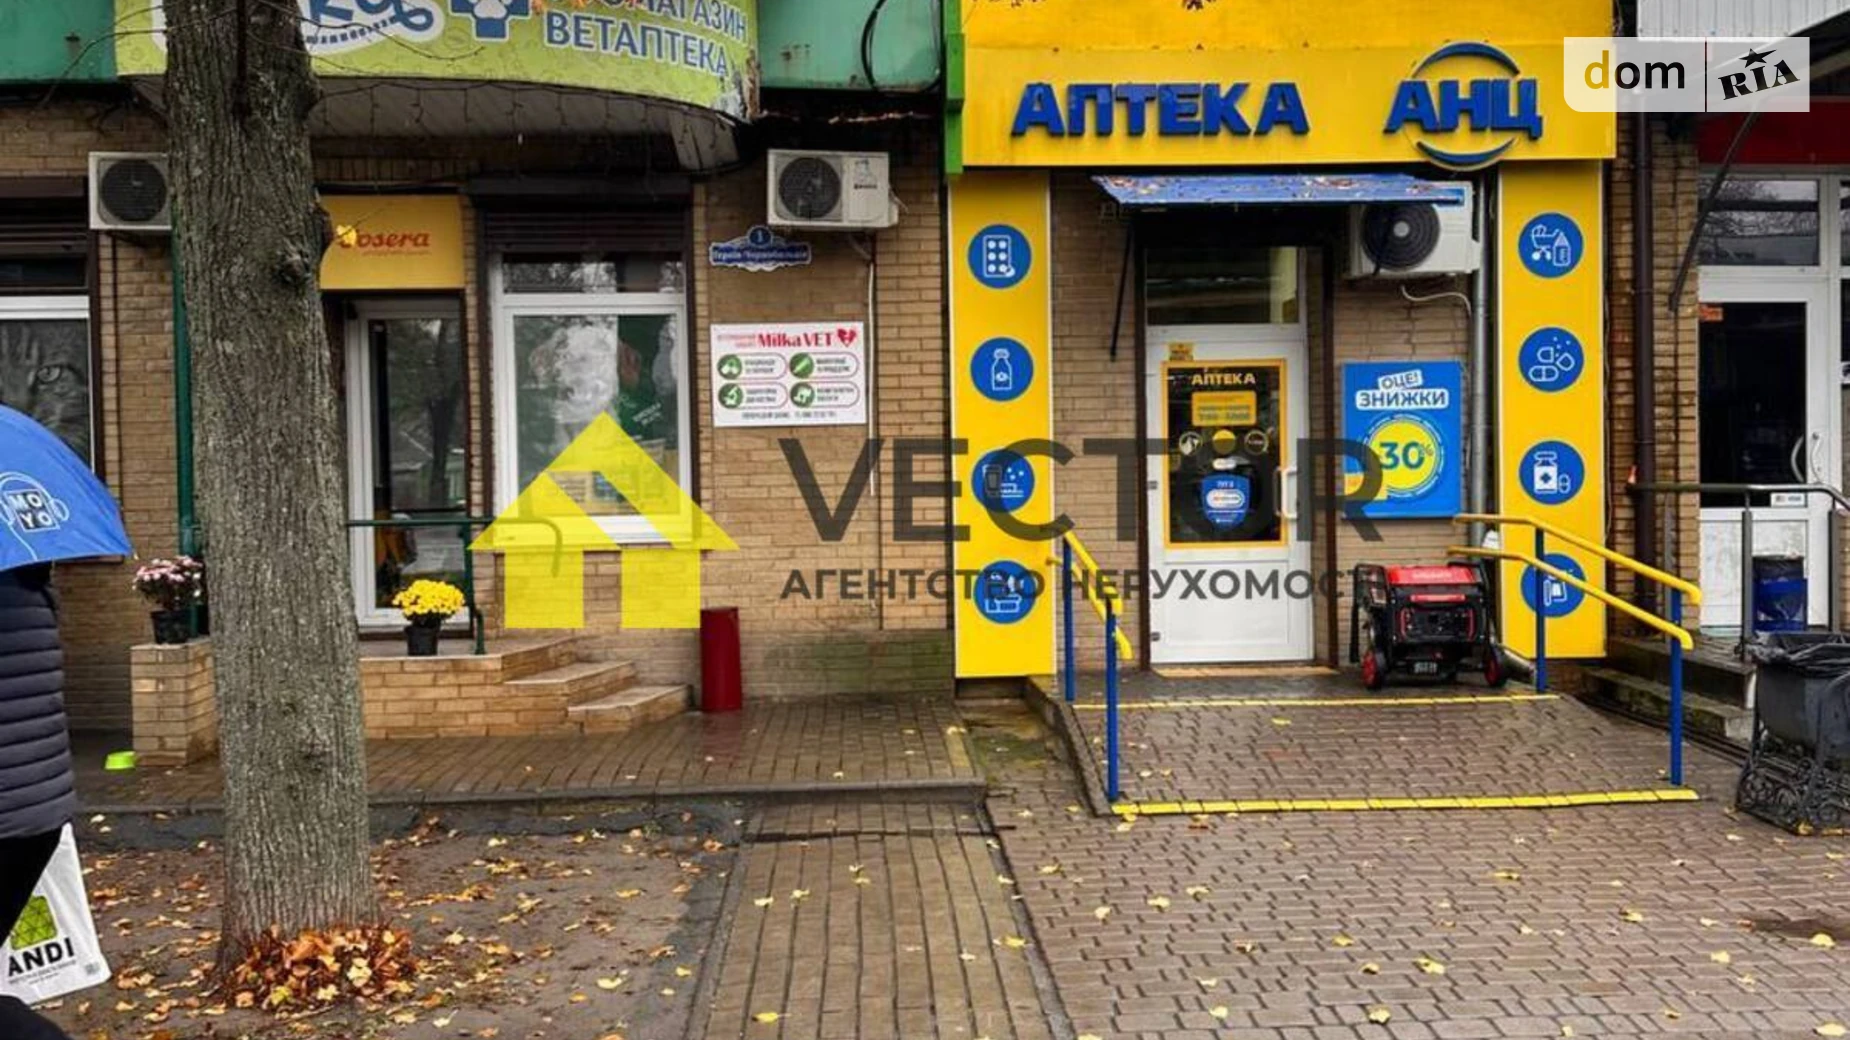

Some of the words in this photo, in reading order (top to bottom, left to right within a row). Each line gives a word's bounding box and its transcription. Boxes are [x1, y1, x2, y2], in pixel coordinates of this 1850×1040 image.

[546, 11, 729, 77] ВЕТАПТЕКА
[1010, 83, 1310, 137] АПТЕКА
[1383, 79, 1543, 141] АНЦ
[340, 229, 430, 248] osera
[758, 332, 802, 348] Milka
[803, 331, 833, 347] VET
[1191, 373, 1256, 386] АПТЕКА
[1360, 391, 1446, 407] ЗНИЖКИ
